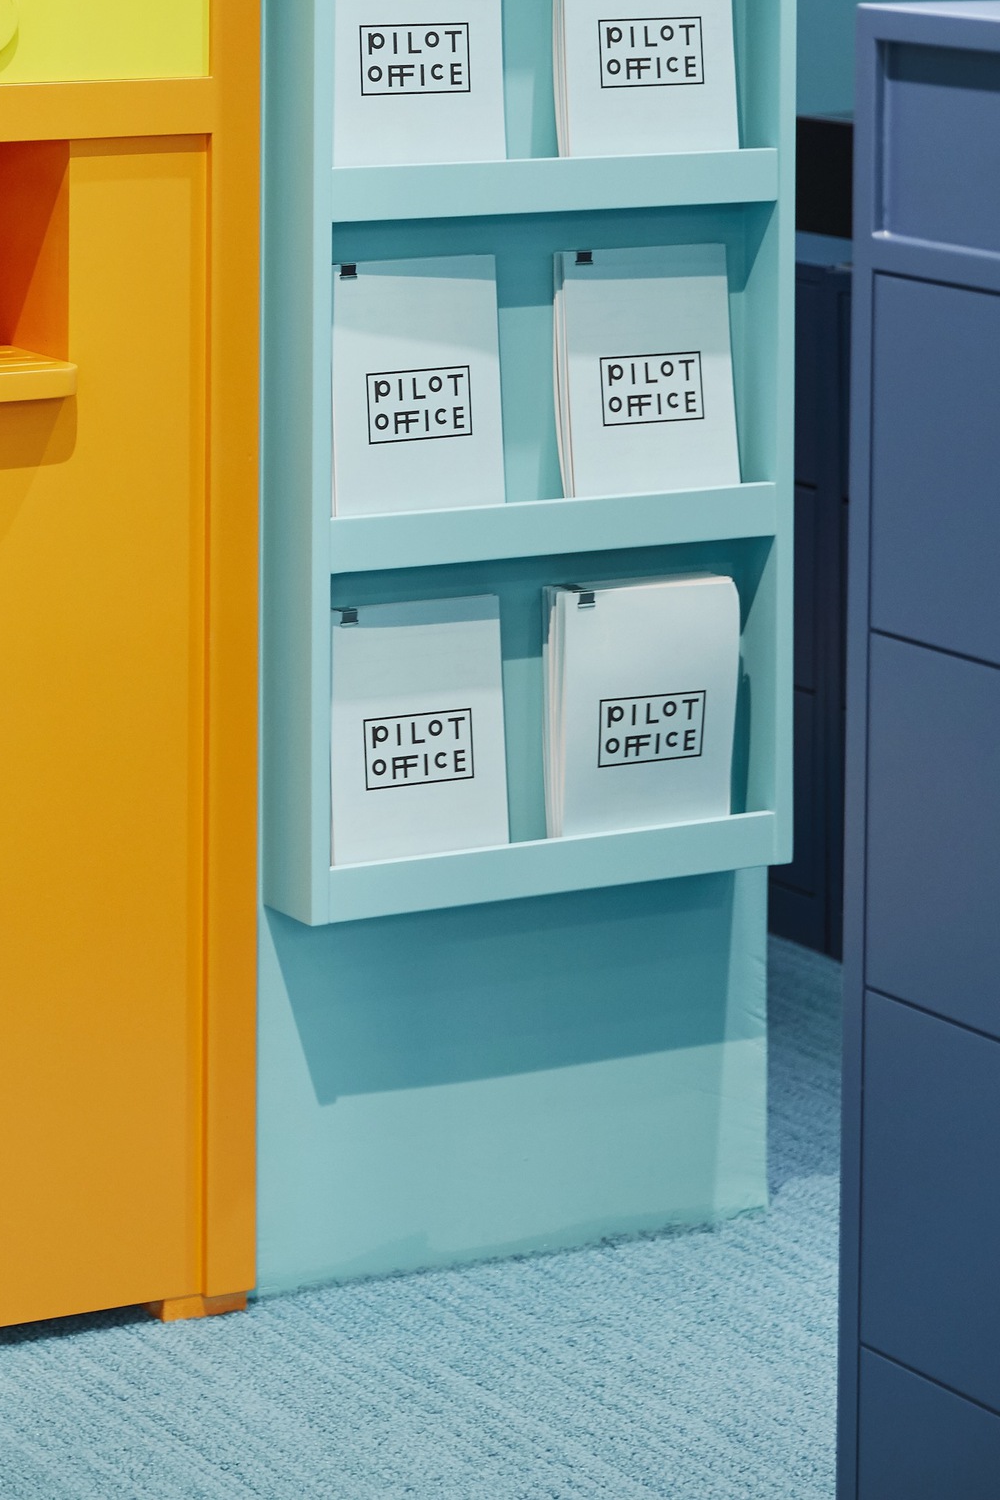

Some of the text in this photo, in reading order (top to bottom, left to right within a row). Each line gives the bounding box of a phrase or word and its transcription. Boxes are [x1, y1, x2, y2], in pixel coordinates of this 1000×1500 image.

[367, 30, 463, 56] PILOT
[606, 24, 696, 49] PILOT
[367, 62, 463, 88] OFFICE
[606, 55, 697, 80] OFFICE
[608, 359, 695, 386] PILOT
[374, 374, 464, 403] PILOT
[608, 391, 697, 417] OFFICE
[374, 406, 466, 434] OFFICE
[607, 698, 700, 728] PILOT
[372, 716, 466, 749] PILOT
[605, 729, 697, 758] OFFICE
[372, 749, 467, 780] OFFICE
